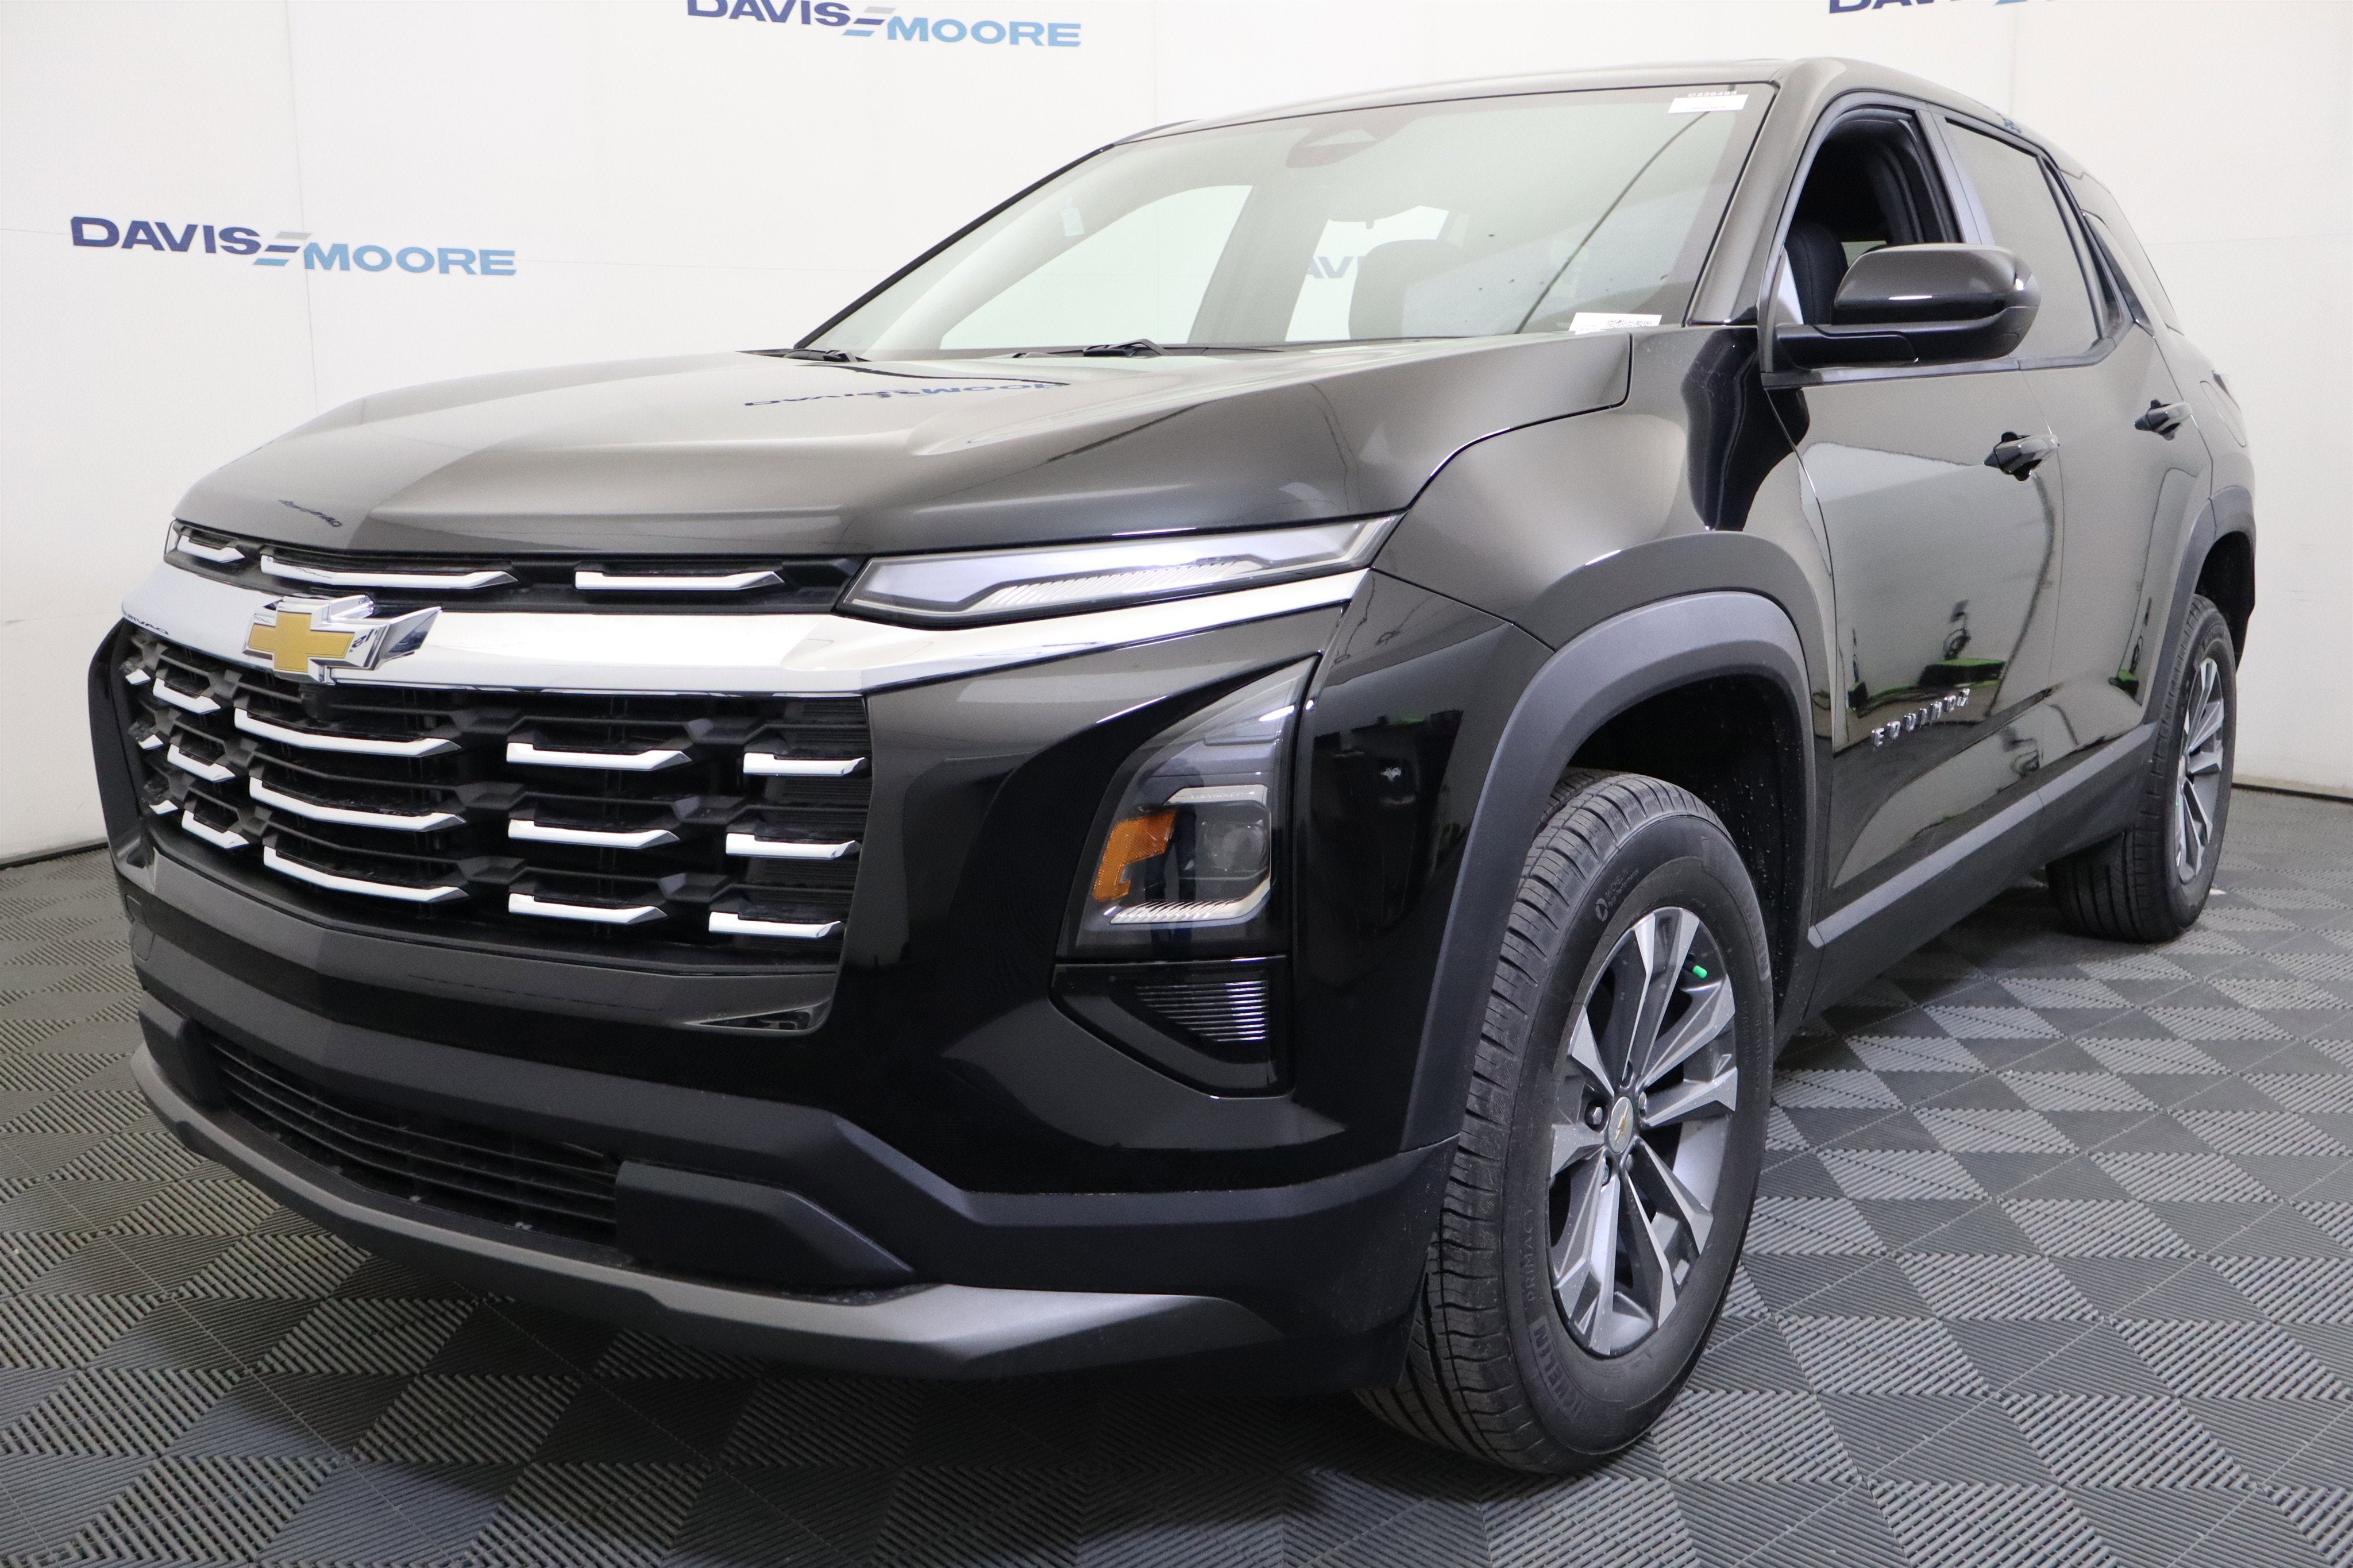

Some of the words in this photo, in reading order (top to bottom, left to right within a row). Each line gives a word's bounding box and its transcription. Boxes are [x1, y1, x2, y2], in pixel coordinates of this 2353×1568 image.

[888, 17, 1081, 47] MOORE
[70, 216, 262, 255] DAVIS
[303, 242, 516, 275] MOORE
[1871, 688, 1970, 747] EQUINOX
[1524, 1209, 1535, 1302] PRIMACY
[1533, 1324, 1594, 1424] ICHELIN
